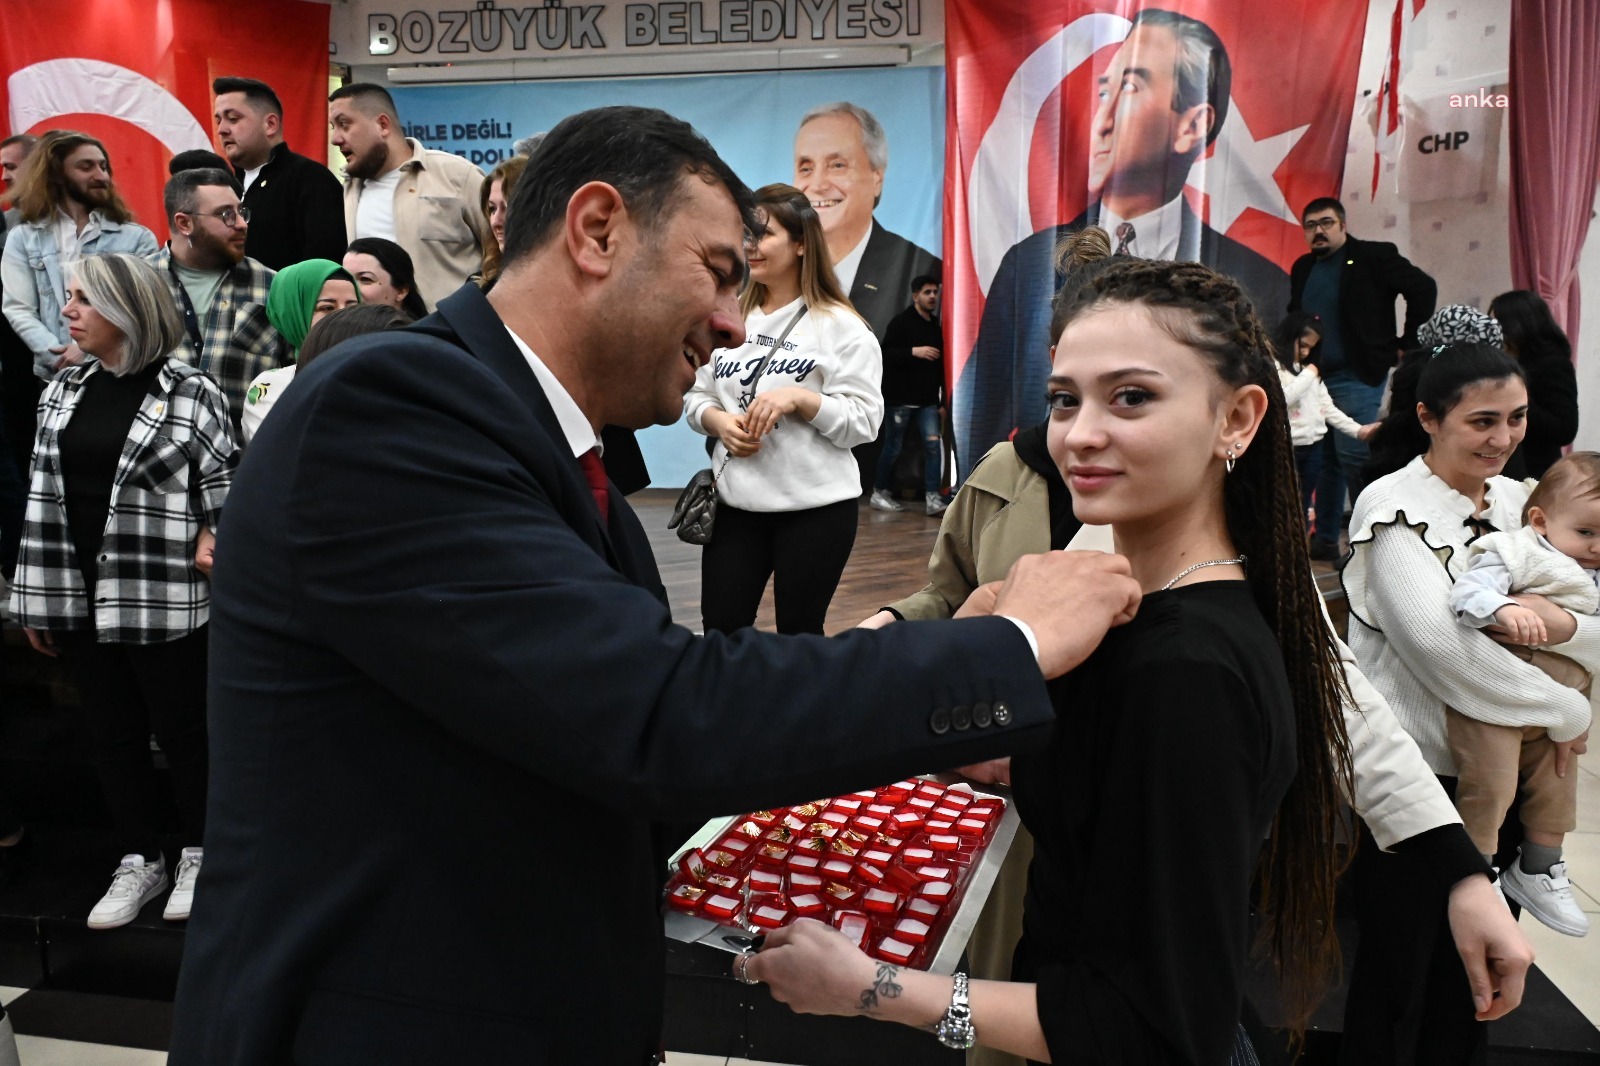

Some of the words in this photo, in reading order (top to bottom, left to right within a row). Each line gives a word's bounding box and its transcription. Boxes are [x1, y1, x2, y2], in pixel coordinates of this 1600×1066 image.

[368, 1, 605, 55] BOZÜYÜK
[451, 118, 512, 141] DEĞİL!
[1418, 131, 1469, 154] CHP
[756, 333, 798, 353] TOURNMENT
[740, 355, 817, 387] Jrsey
